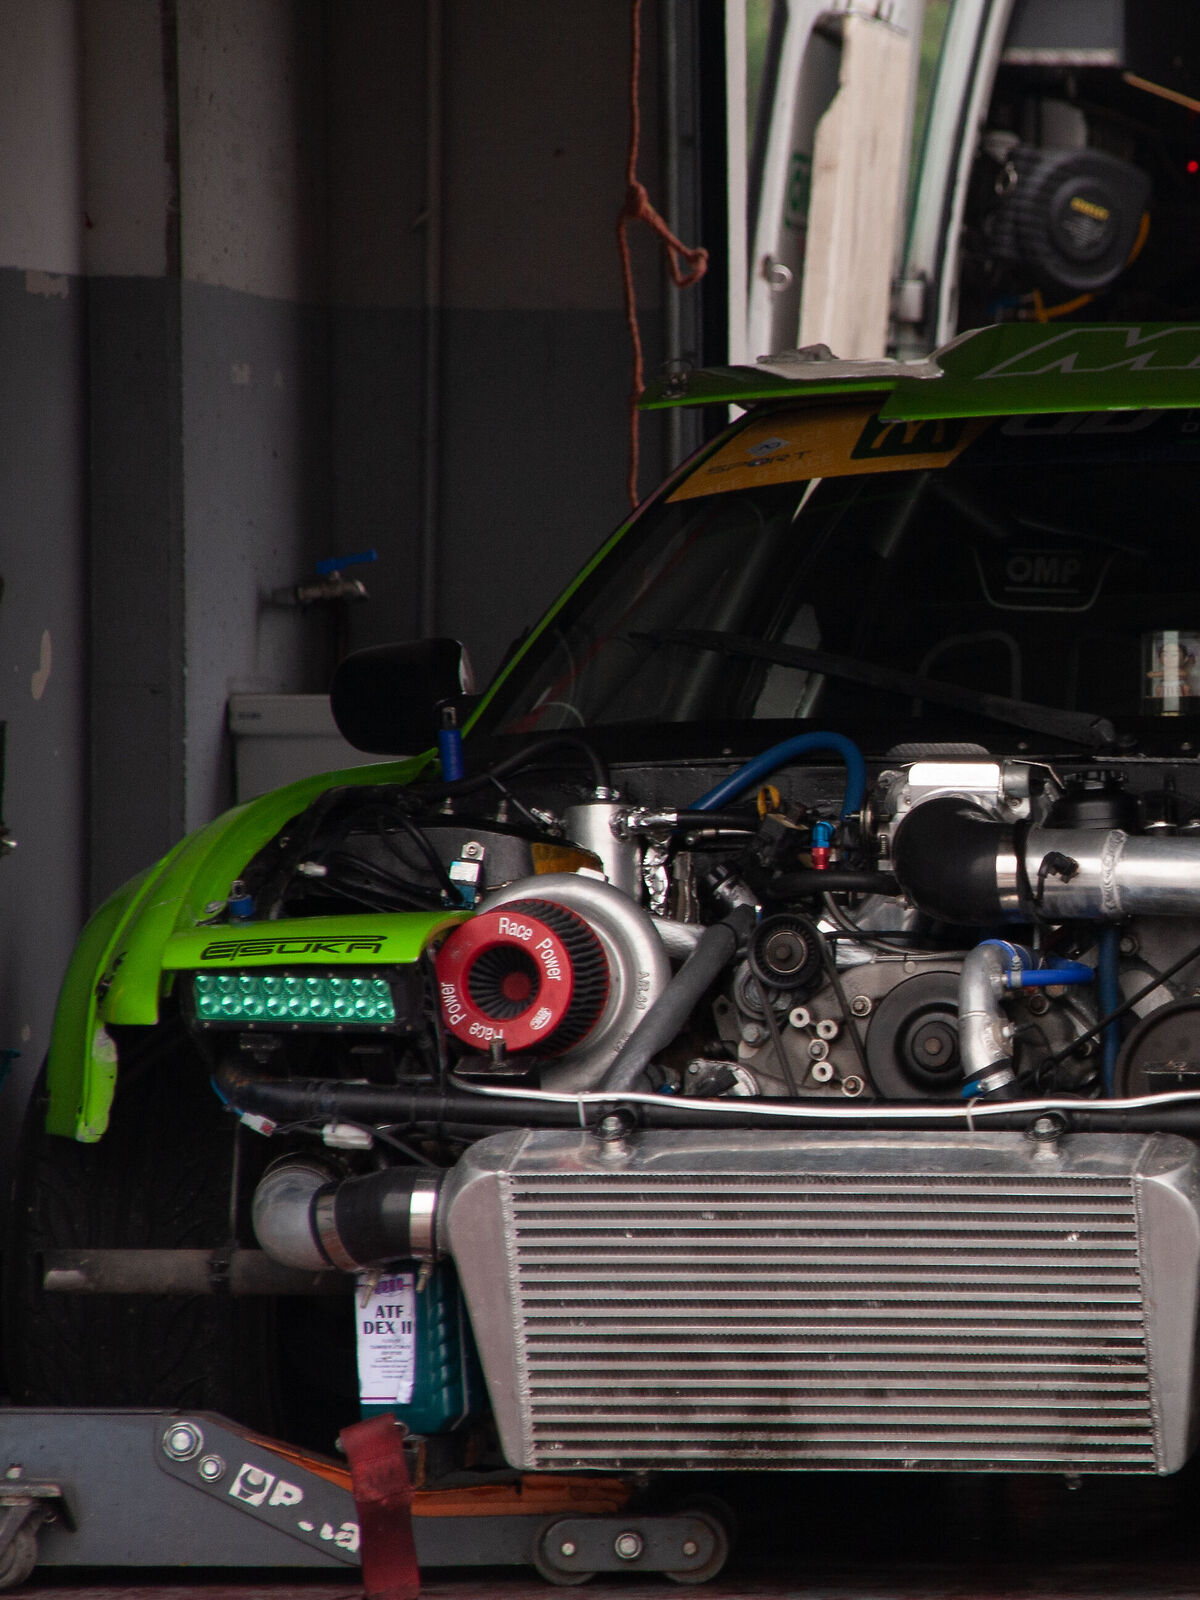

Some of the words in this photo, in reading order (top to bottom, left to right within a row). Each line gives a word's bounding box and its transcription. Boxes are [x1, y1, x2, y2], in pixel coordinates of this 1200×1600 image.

[1005, 555, 1081, 583] OMP
[498, 917, 533, 941] Race
[535, 937, 562, 981] Power
[440, 982, 467, 1026] Power
[375, 1305, 404, 1318] ATF
[363, 1321, 394, 1335] DEX
